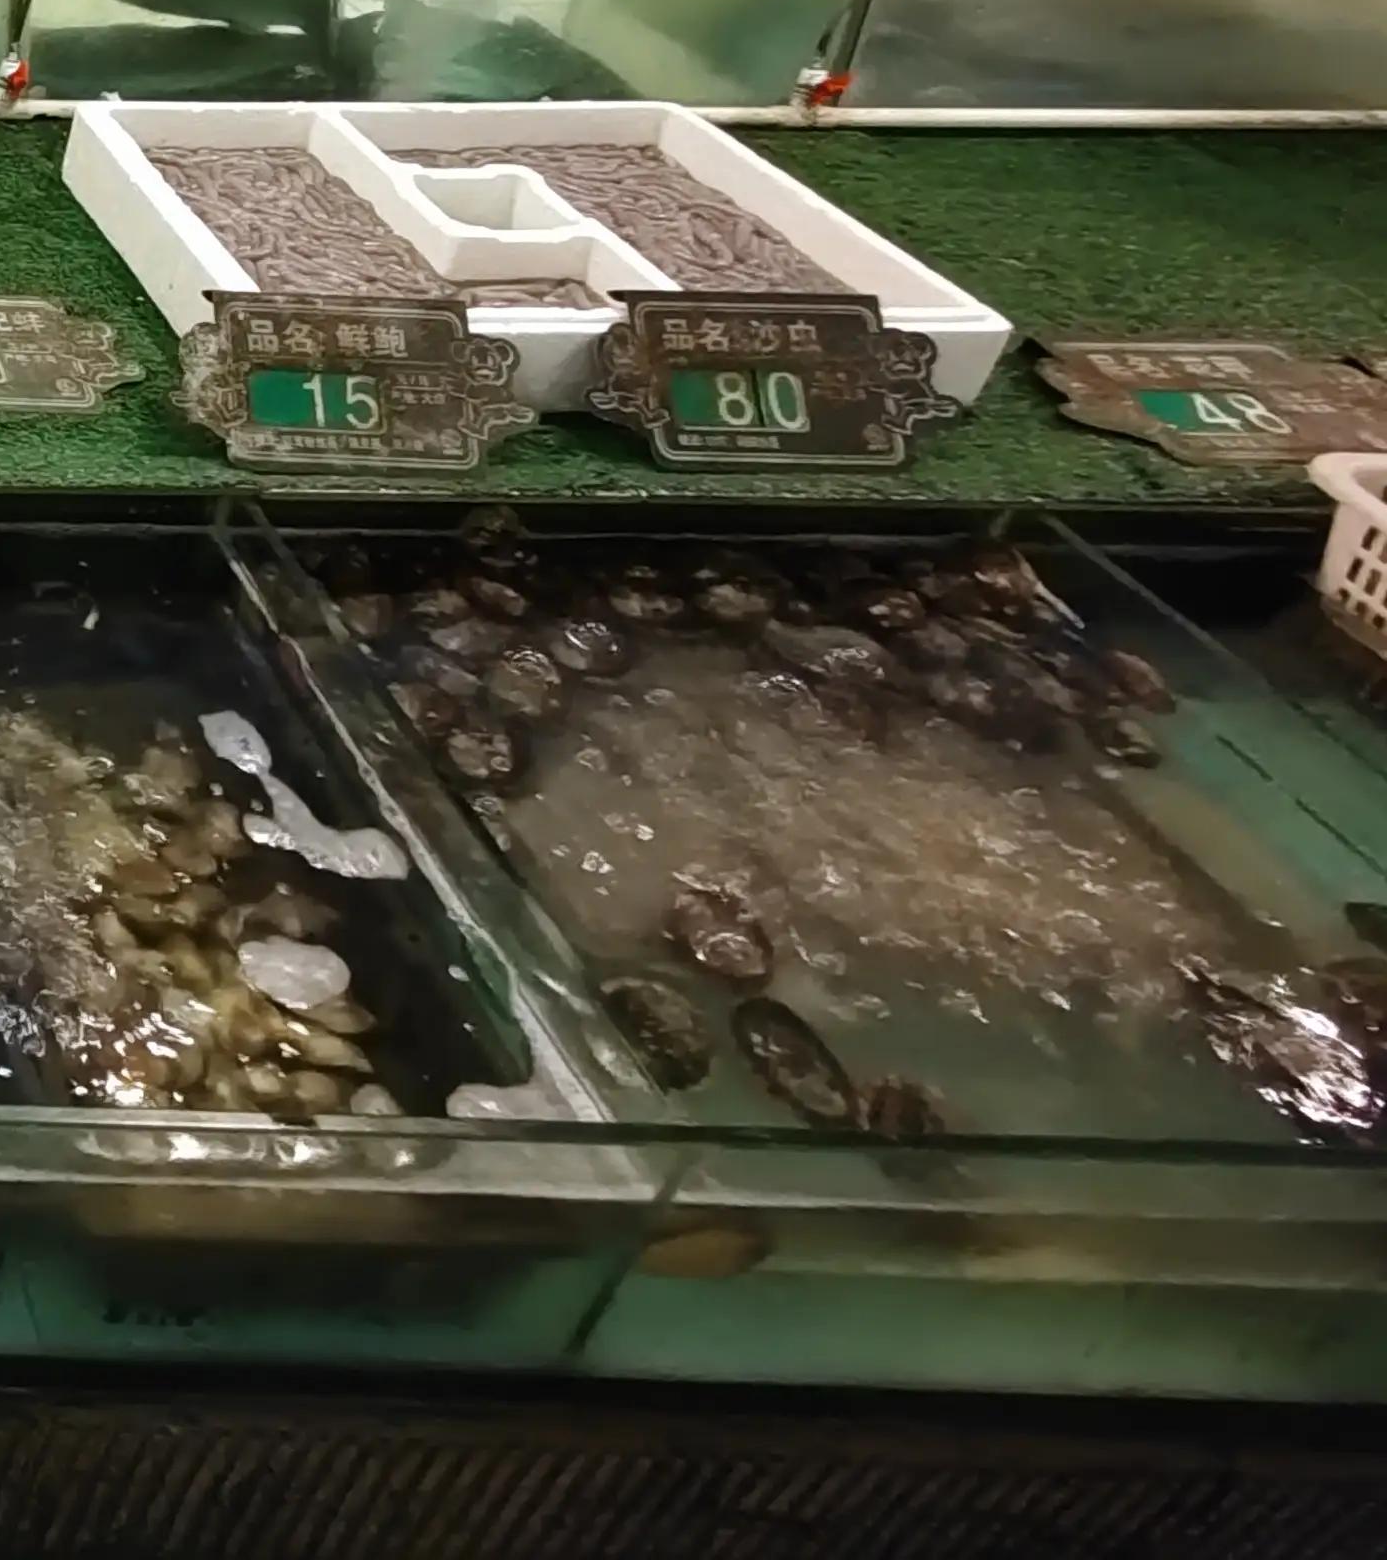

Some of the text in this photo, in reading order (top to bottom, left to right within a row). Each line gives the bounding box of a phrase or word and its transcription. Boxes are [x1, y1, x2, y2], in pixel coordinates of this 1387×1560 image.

[303, 374, 379, 430] 15
[715, 370, 806, 430] 80
[1191, 392, 1294, 434] 48
